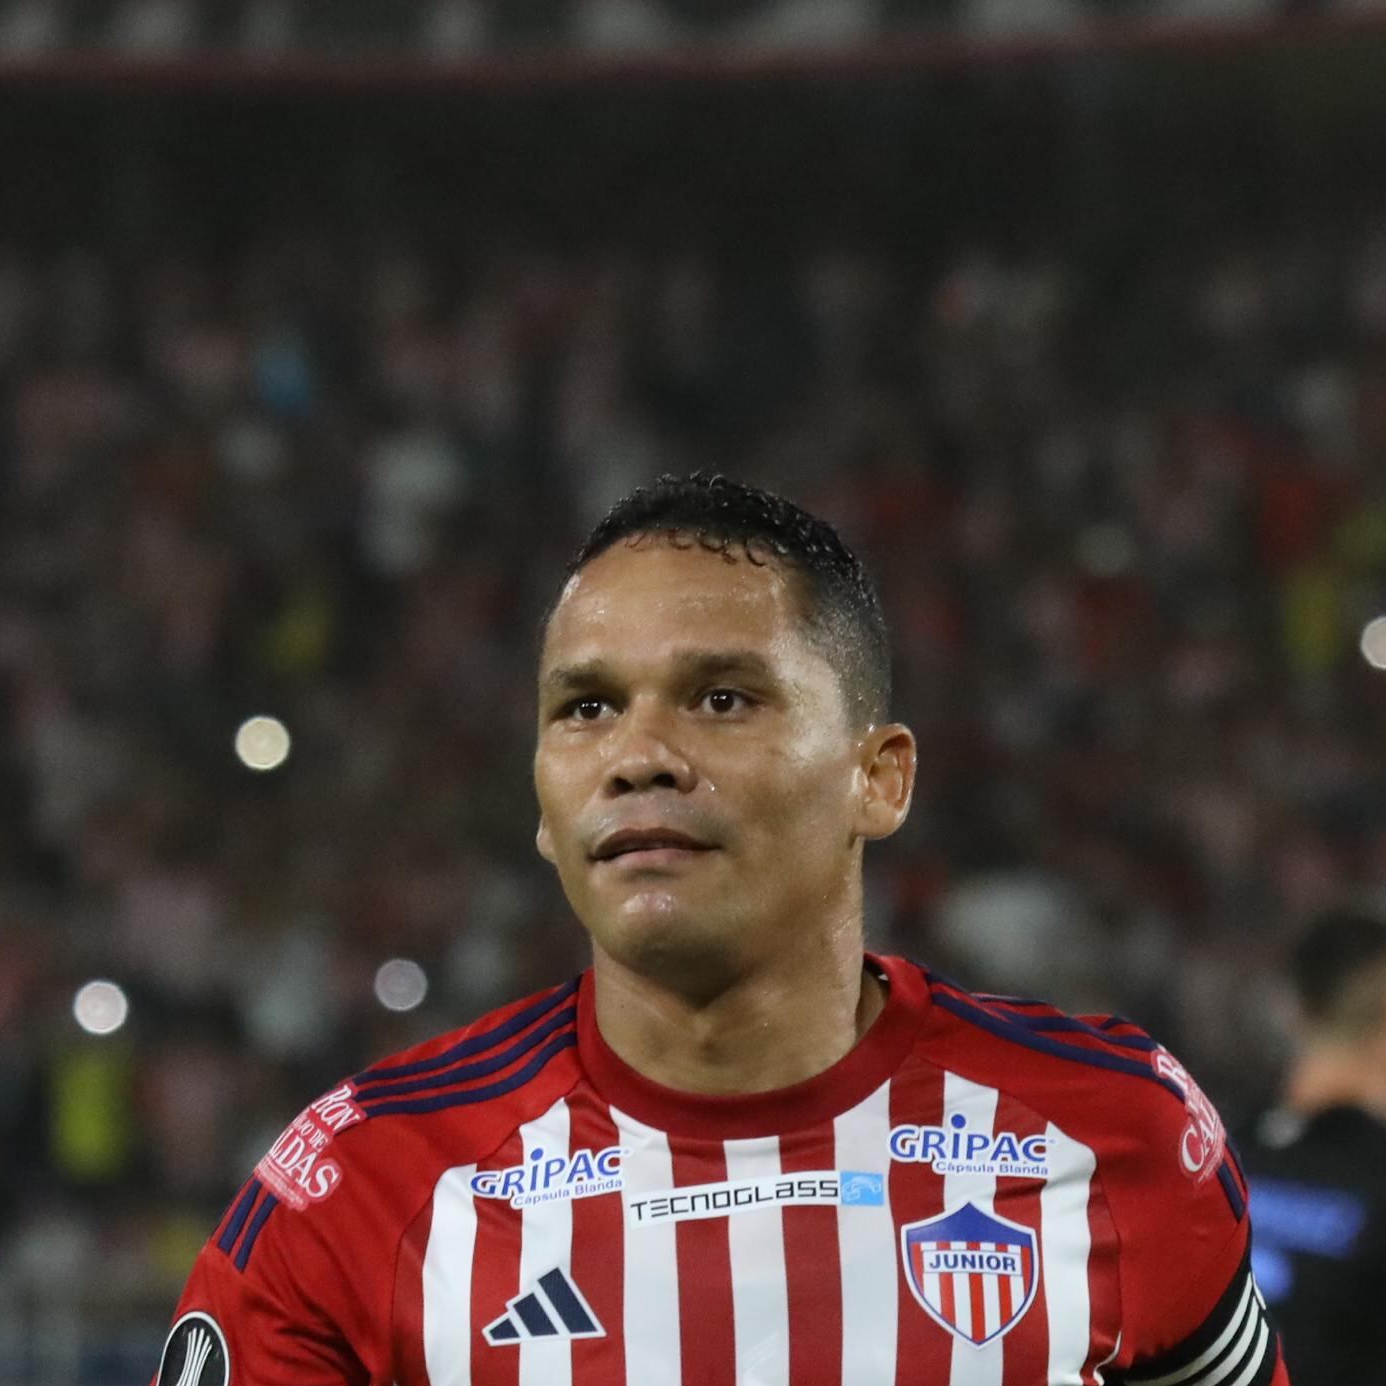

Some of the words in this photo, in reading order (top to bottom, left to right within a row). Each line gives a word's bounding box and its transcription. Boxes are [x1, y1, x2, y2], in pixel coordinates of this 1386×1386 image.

[311, 1084, 361, 1132] RON
[269, 1127, 339, 1198] LDAS
[999, 1162, 1049, 1176] Blanda
[574, 1178, 623, 1196] Blanda
[928, 1253, 1017, 1272] JUNIOR
